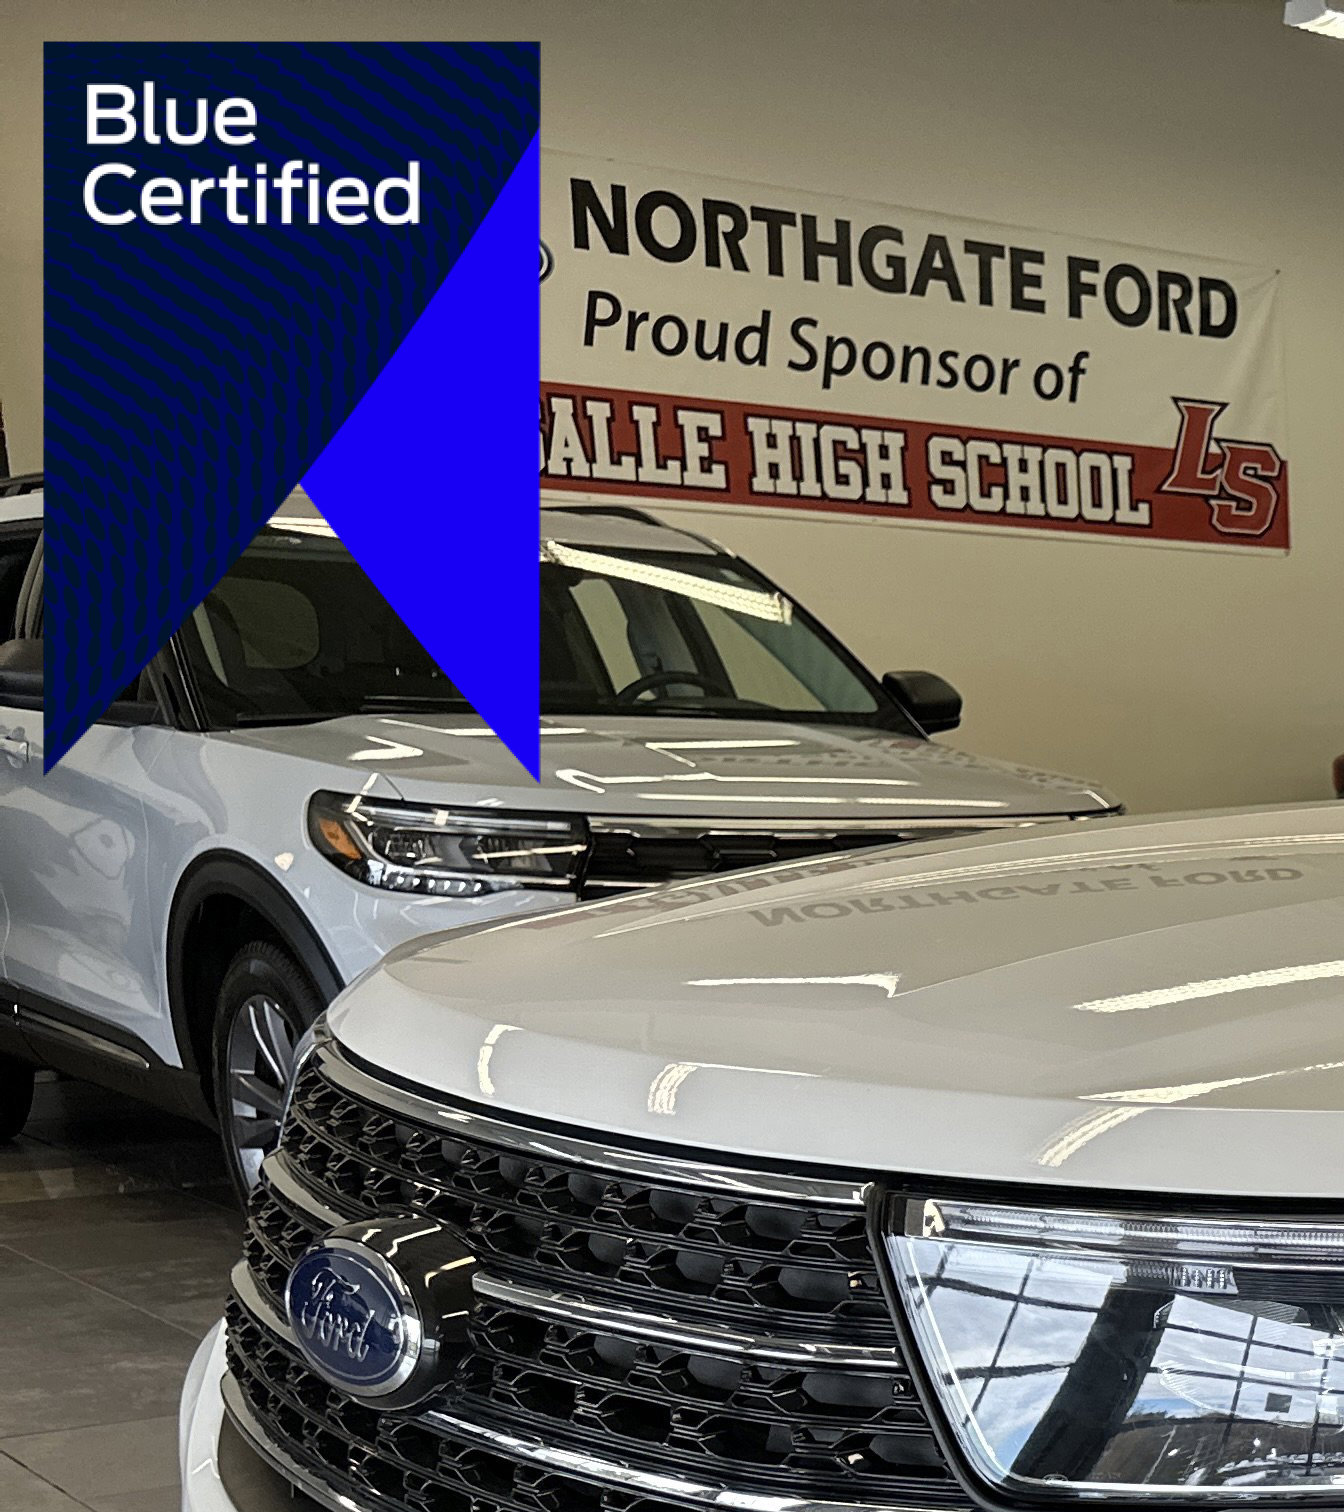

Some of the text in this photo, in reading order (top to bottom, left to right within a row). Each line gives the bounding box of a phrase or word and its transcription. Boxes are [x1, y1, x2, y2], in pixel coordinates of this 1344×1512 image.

[569, 177, 1239, 340] NORTHGATE FORD
[583, 290, 1090, 403] Proud Sponsor of
[746, 416, 909, 506] HIGH
[927, 433, 1151, 528] SCHOOL
[1158, 396, 1285, 537] LS
